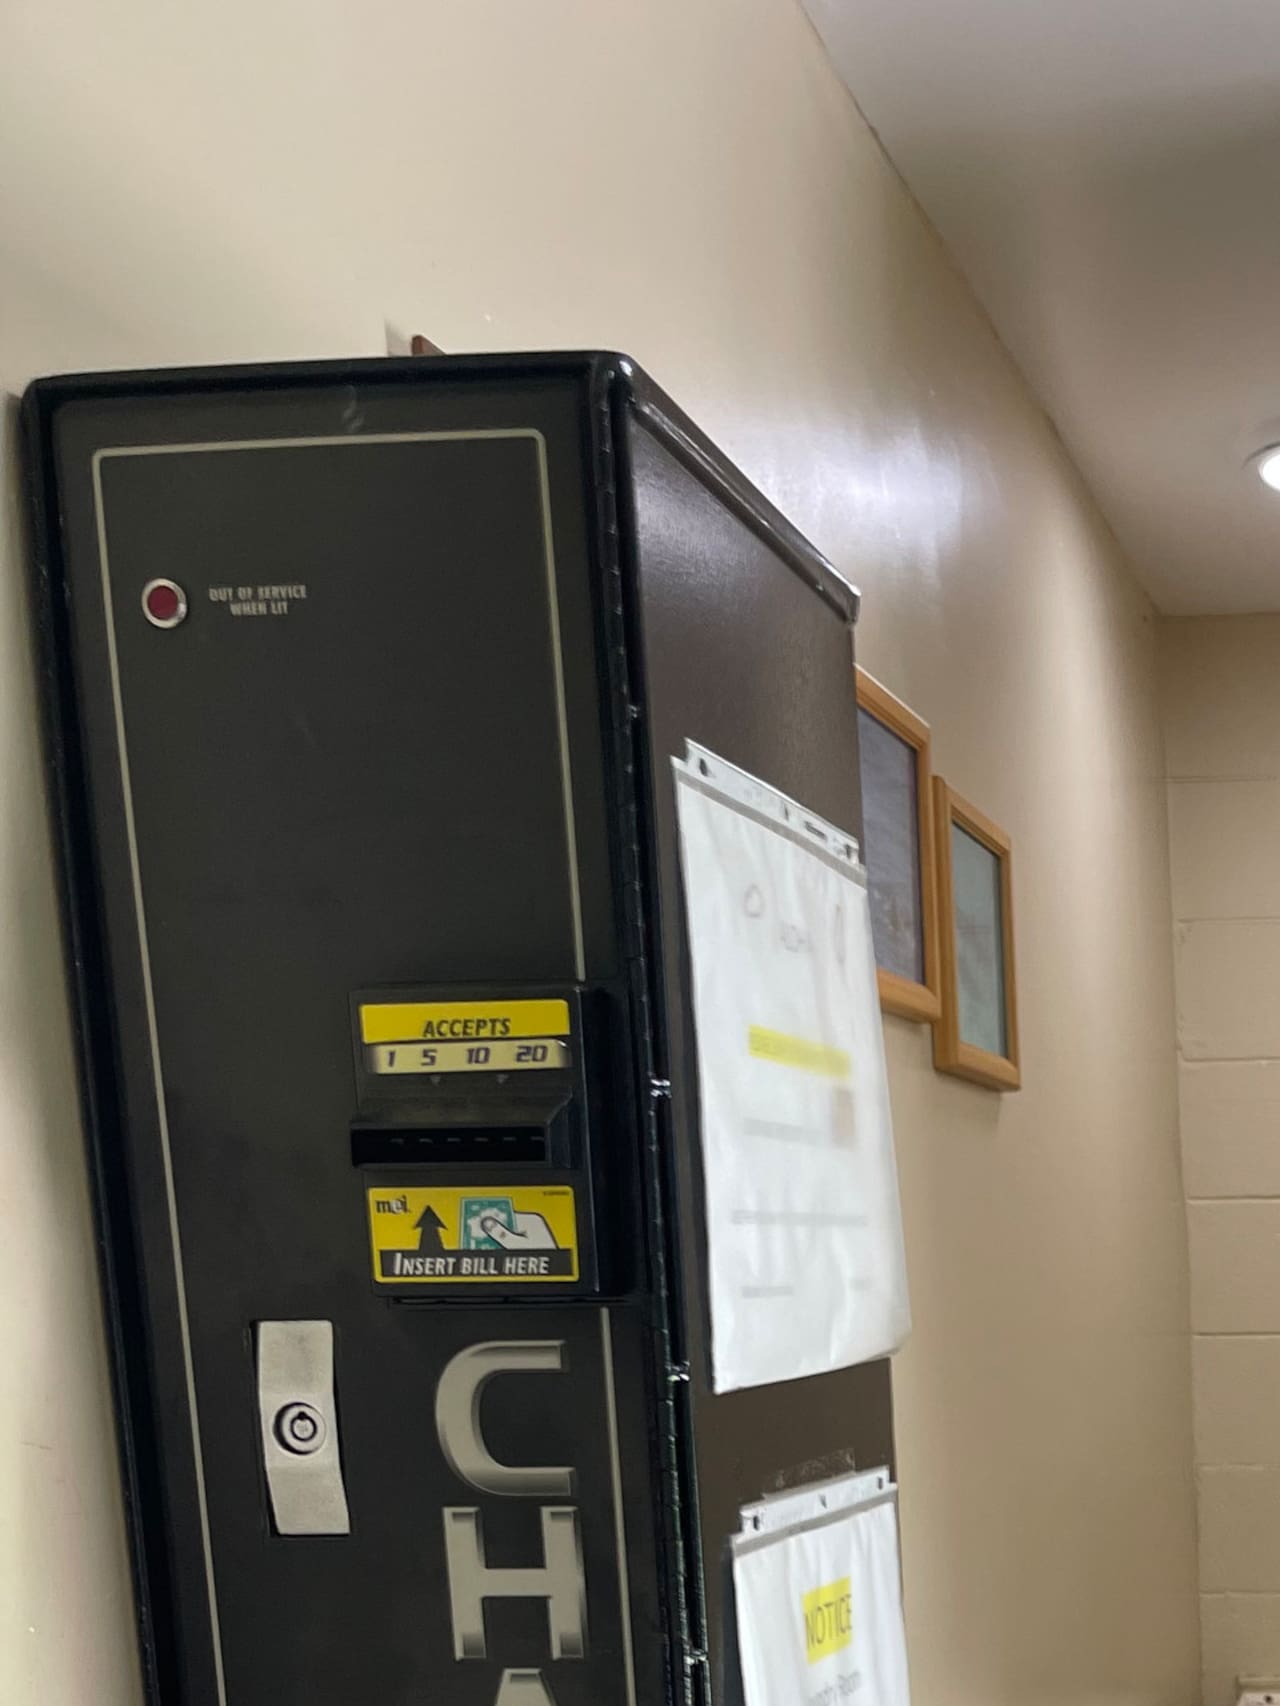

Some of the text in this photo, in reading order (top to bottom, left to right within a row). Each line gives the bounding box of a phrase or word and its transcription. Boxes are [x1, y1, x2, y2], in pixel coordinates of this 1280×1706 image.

[209, 584, 307, 601] OUT OF SERVICE
[230, 601, 288, 615] WHEN LIT
[423, 1017, 511, 1038] ACCEPTS
[387, 1045, 548, 1067] 1 5 10 20
[393, 1252, 550, 1275] INSERT BILL HERE
[804, 1593, 852, 1650] NOTICE
